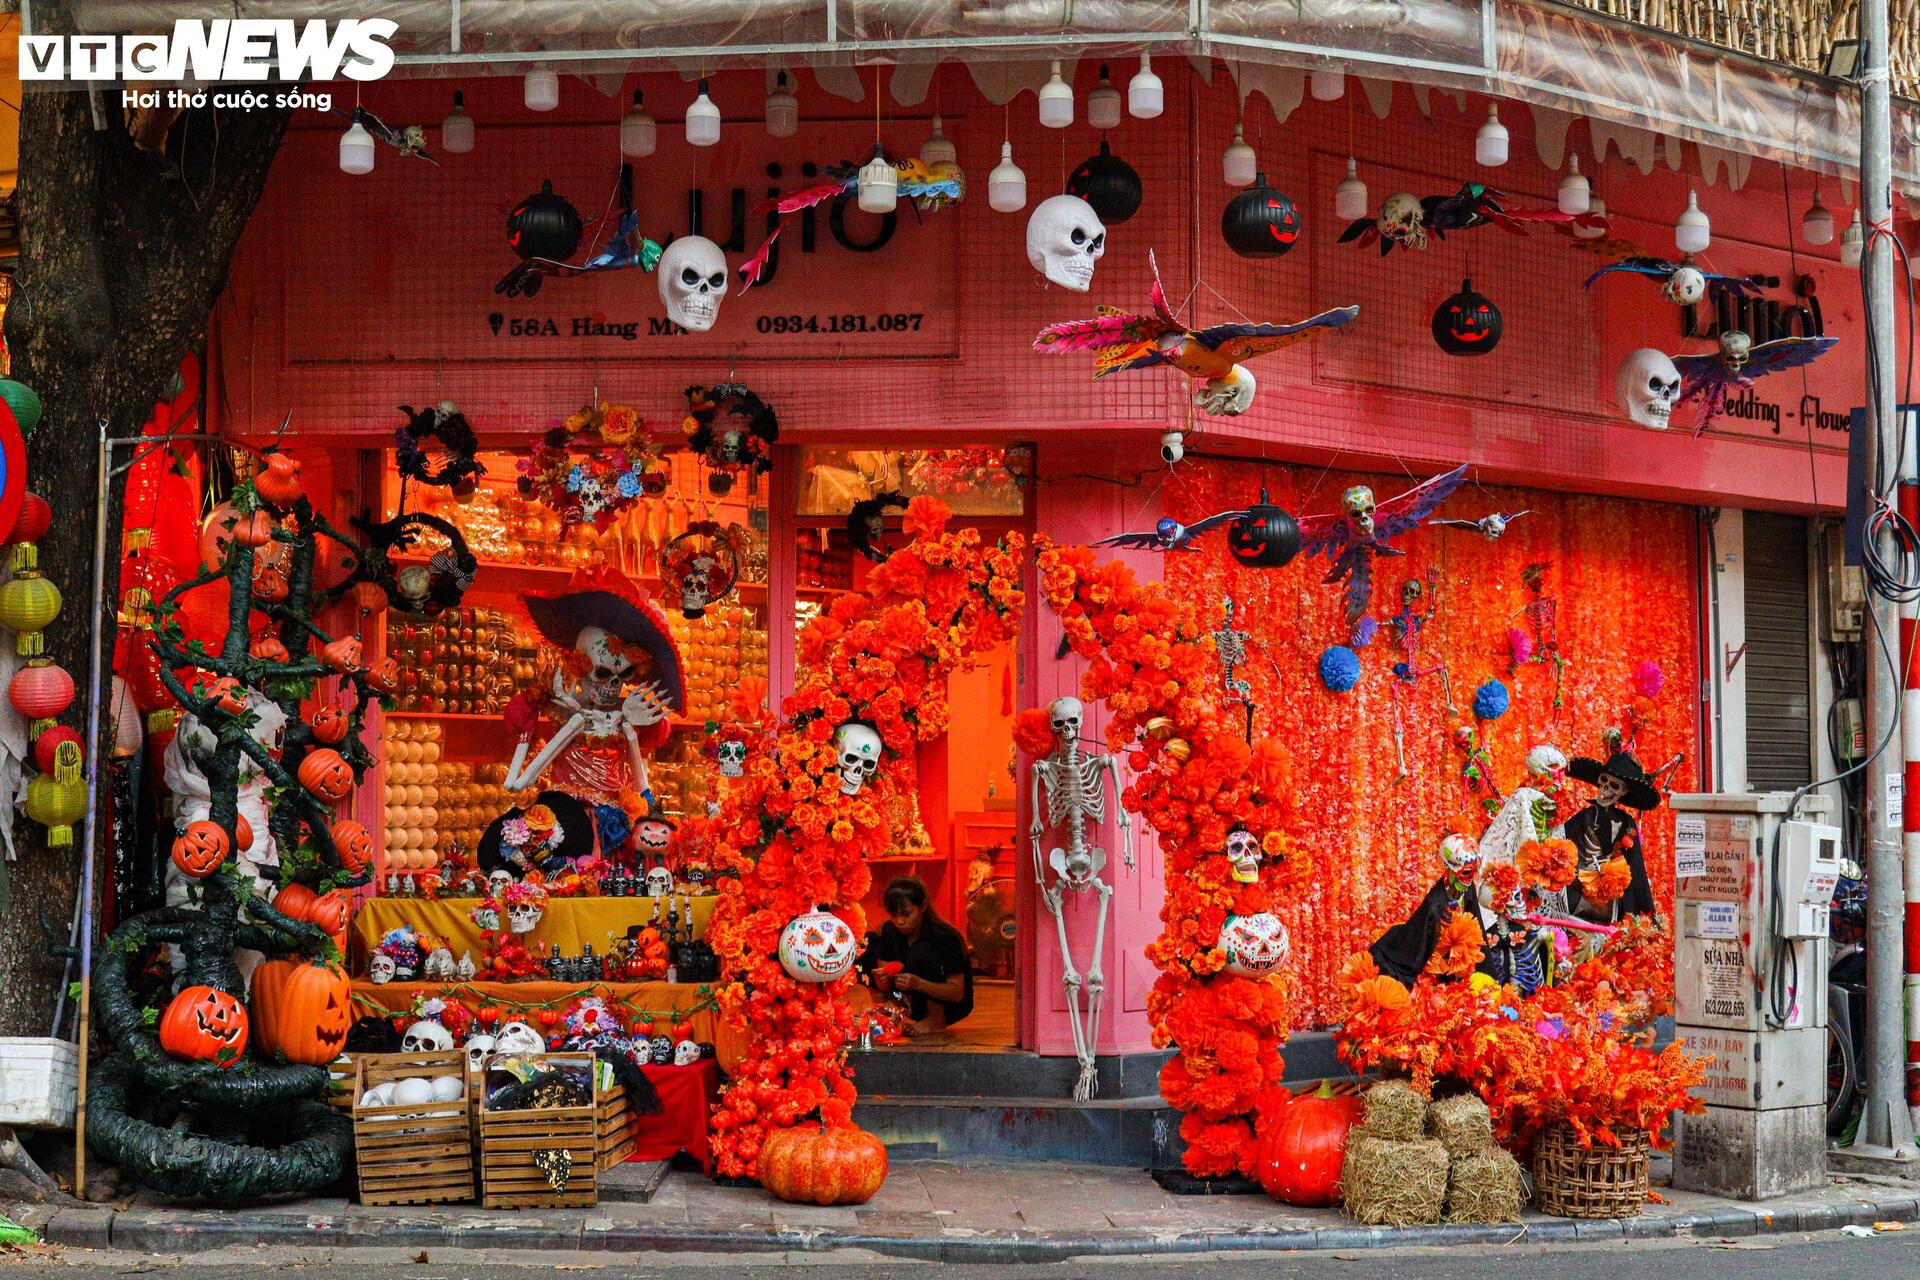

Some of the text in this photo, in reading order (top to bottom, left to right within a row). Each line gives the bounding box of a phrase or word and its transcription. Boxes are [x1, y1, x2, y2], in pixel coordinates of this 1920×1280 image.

[509, 318, 559, 337] 58A
[756, 314, 924, 334] 0934.181.087
[1715, 387, 1780, 435] edding
